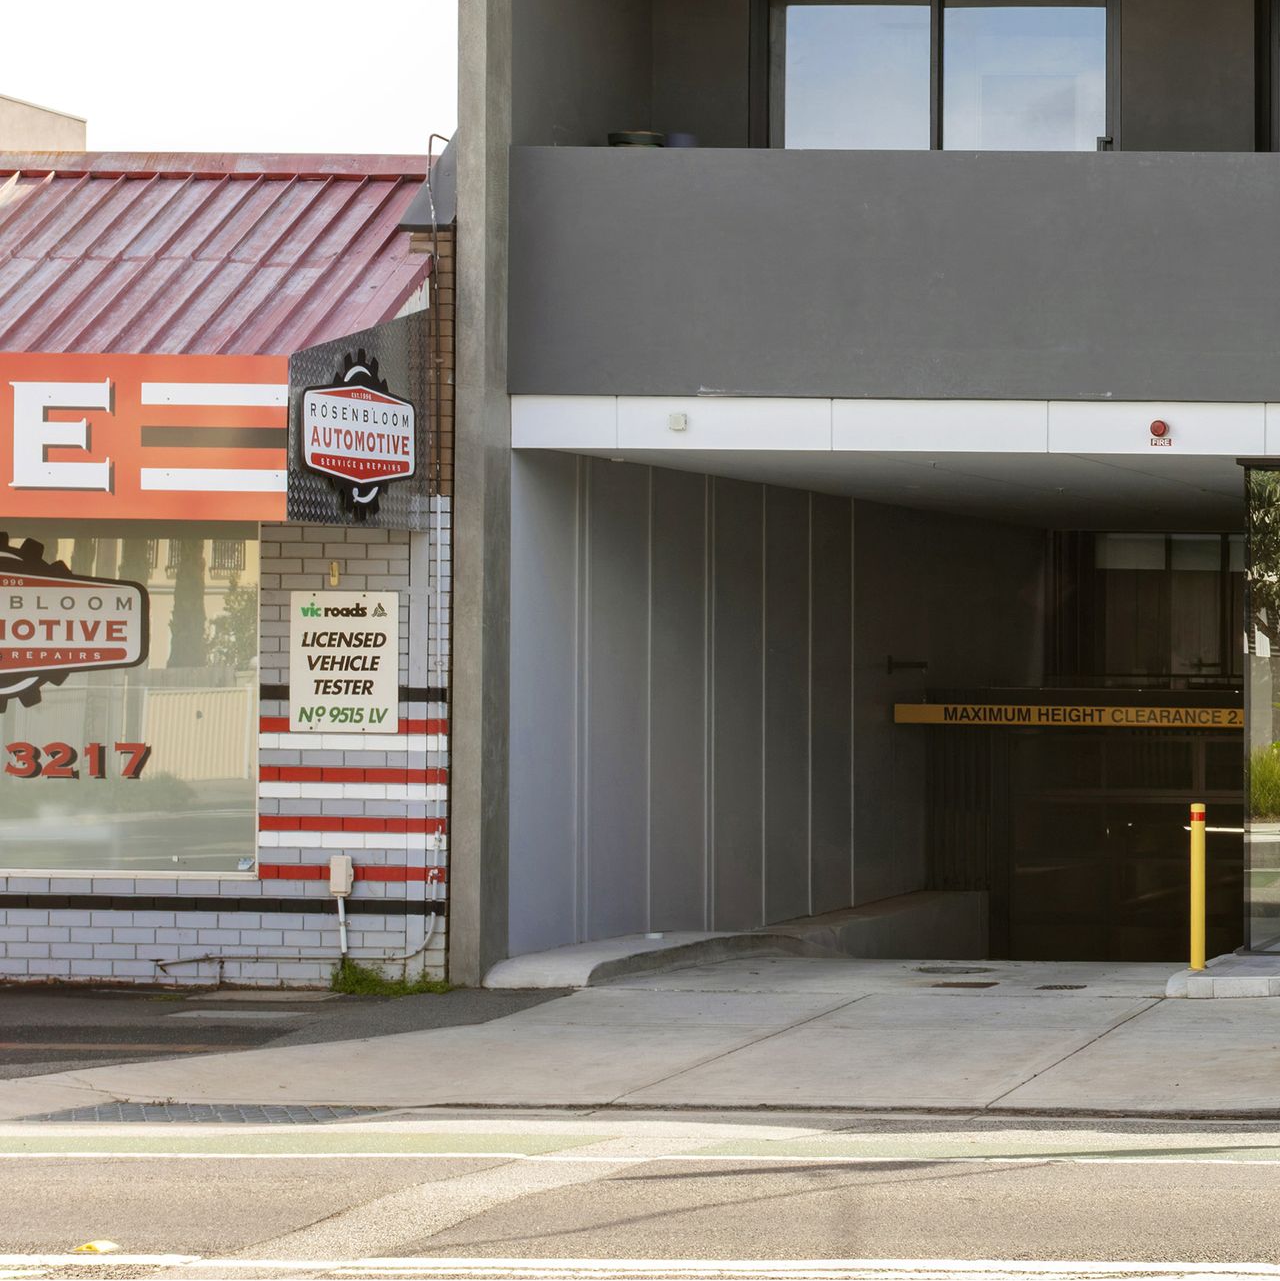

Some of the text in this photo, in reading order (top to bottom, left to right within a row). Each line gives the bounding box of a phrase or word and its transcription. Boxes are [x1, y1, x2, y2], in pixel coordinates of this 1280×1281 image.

[310, 403, 409, 428] ROSENBLOOM
[311, 425, 410, 456] AUTOMOTIVE
[1152, 438, 1170, 446] FIRE
[321, 457, 357, 469] SERVICE
[366, 463, 401, 472] REPAIRS
[324, 603, 367, 618] roads
[0, 619, 127, 642] OTIVE
[301, 631, 387, 648] LICENSED
[12, 651, 101, 660] REPAIRS
[307, 655, 380, 671] VEHICLE
[314, 679, 374, 696] TESTER
[329, 707, 364, 724] 9515
[368, 708, 389, 724] LV
[943, 707, 1032, 722] MAXIMUM
[1037, 708, 1106, 723] HEIGHT
[1111, 709, 1222, 724] CLEARANCE
[5, 742, 152, 780] 3217
